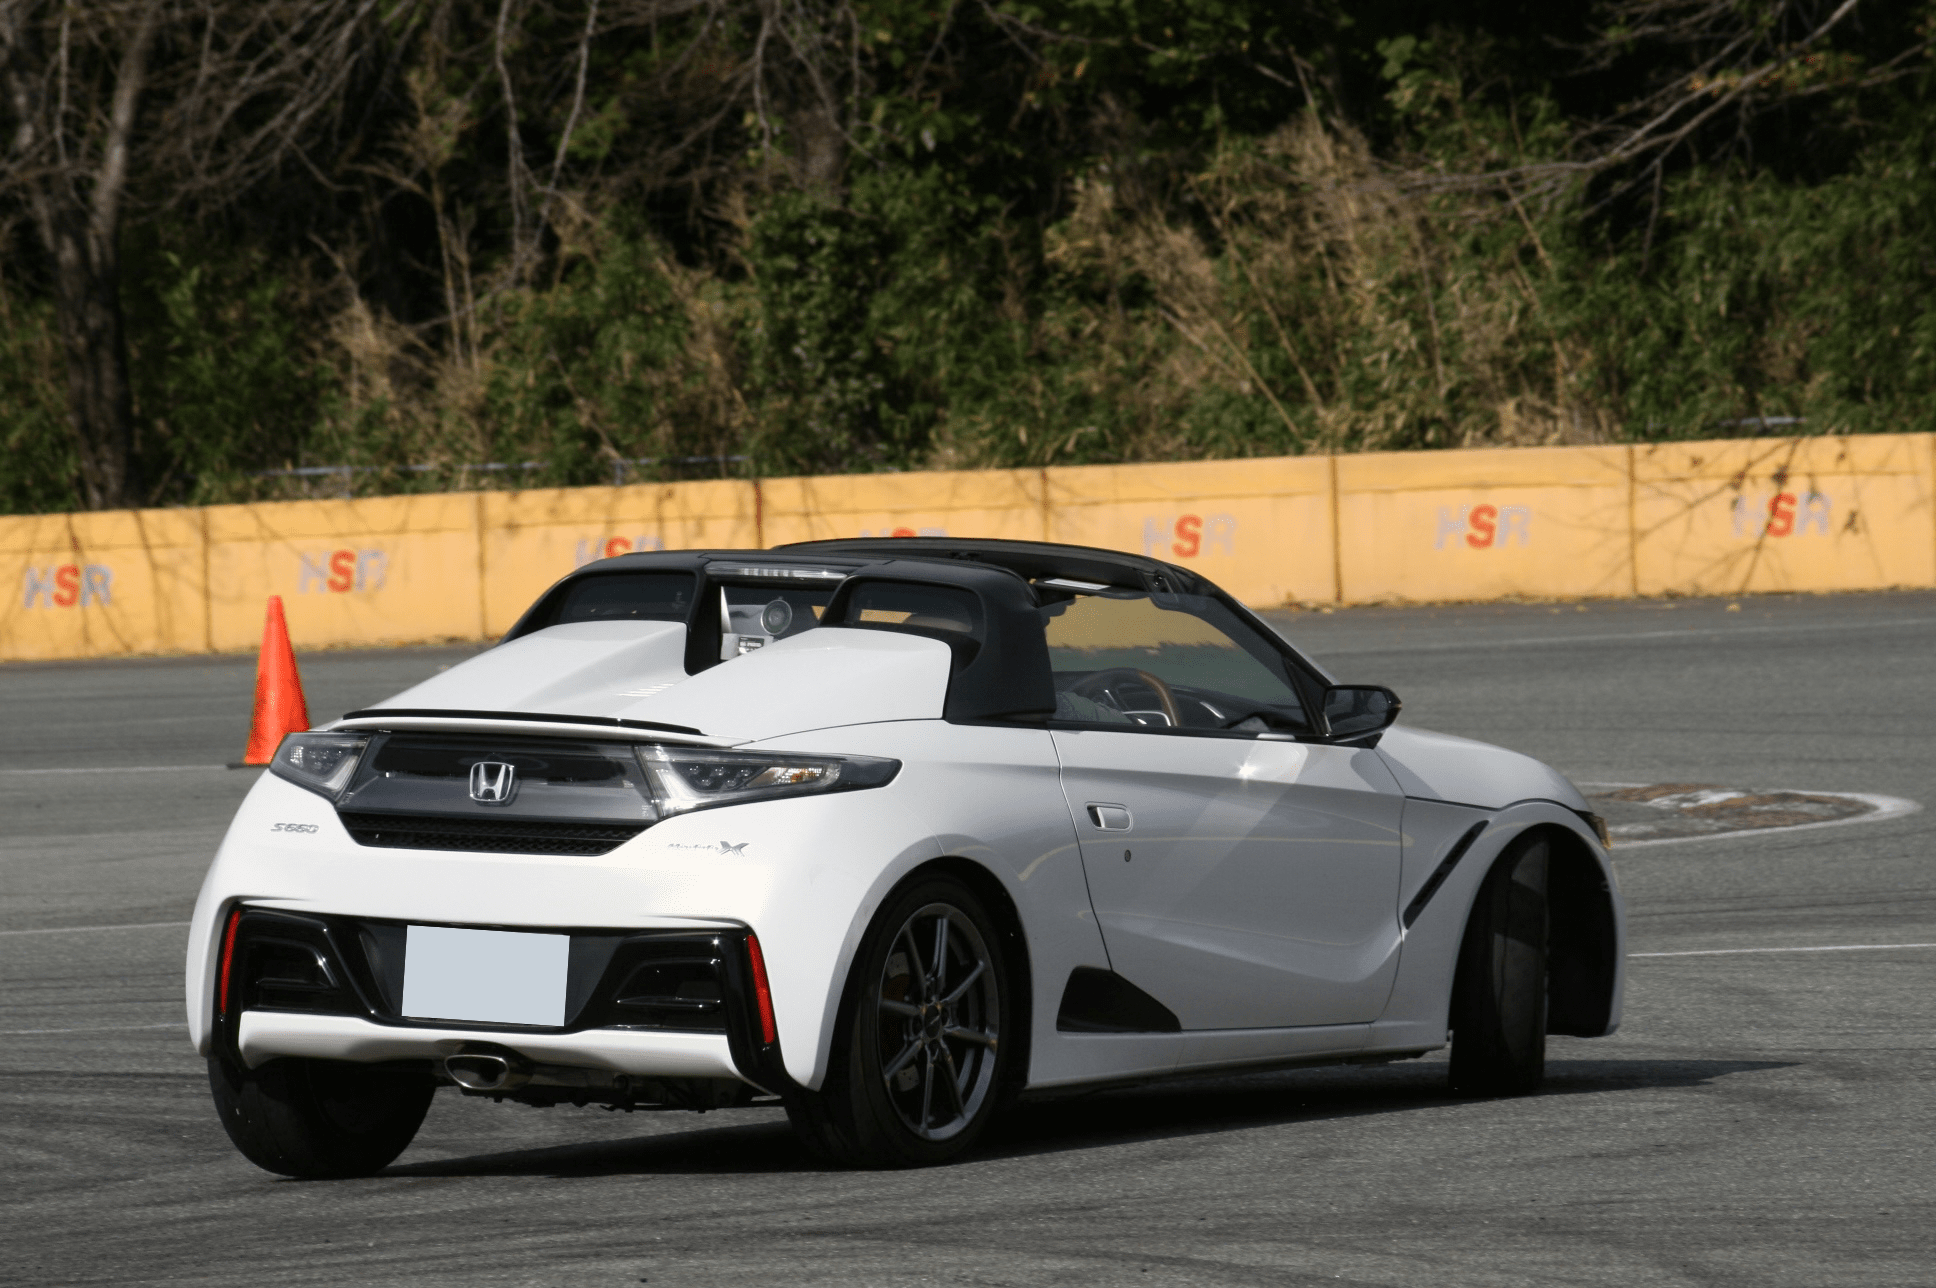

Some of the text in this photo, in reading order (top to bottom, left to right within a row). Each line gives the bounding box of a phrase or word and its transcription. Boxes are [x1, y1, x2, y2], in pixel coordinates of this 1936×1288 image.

[1142, 513, 1237, 558] HSR
[1434, 503, 1531, 551] HSR
[1731, 492, 1832, 538] HSR
[23, 563, 113, 609] HSR
[297, 549, 388, 594] HSR
[270, 822, 319, 834] S660
